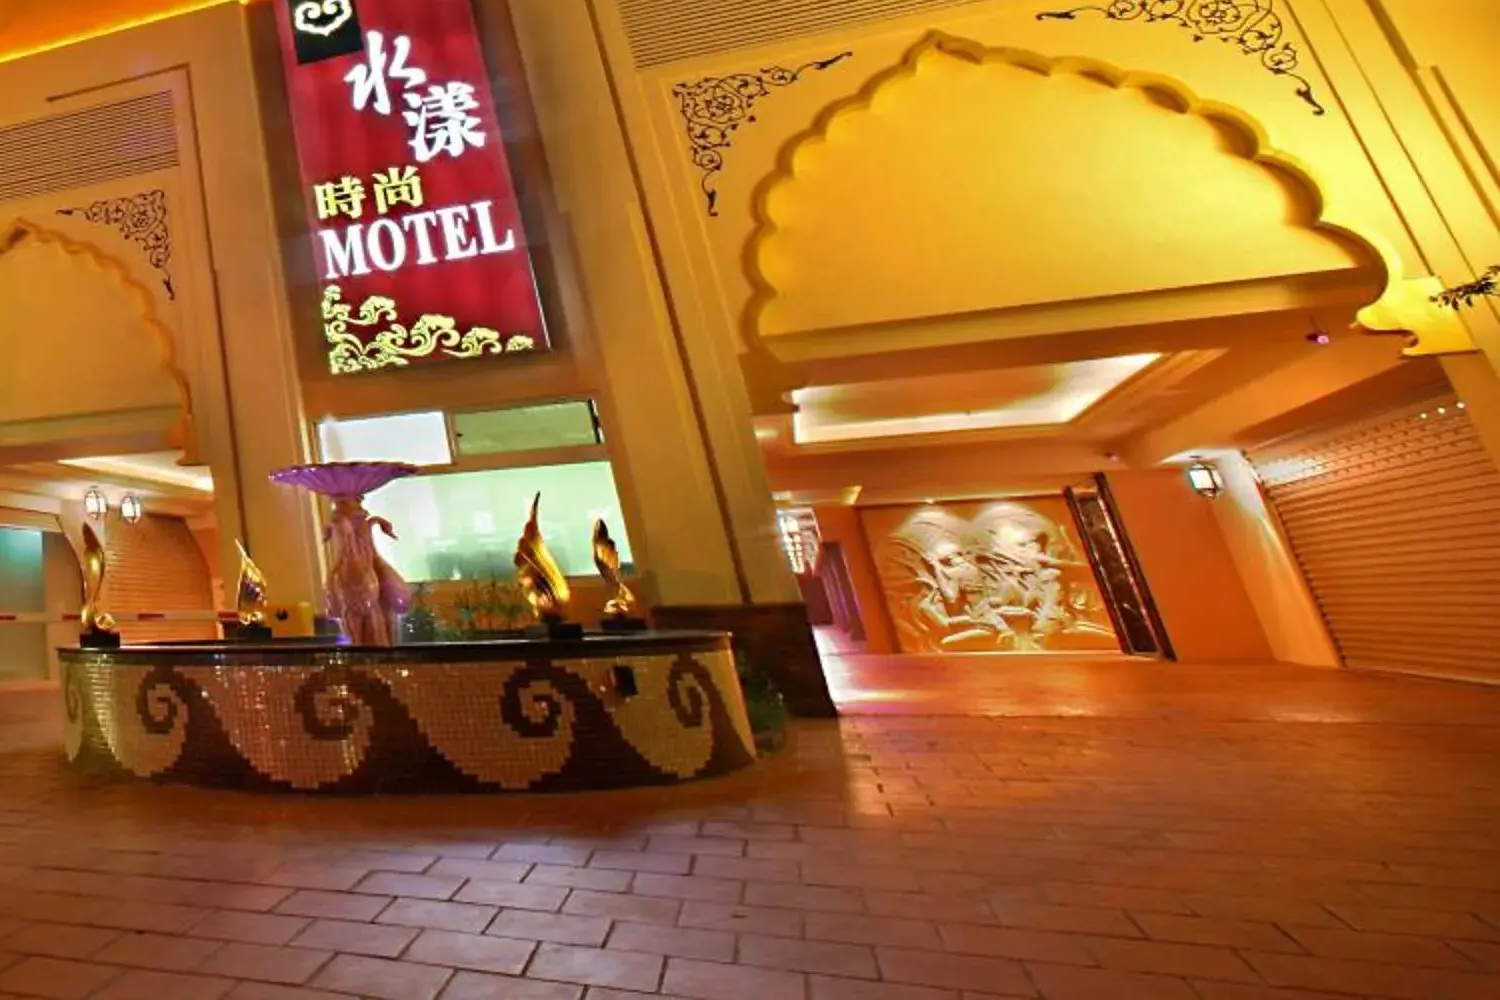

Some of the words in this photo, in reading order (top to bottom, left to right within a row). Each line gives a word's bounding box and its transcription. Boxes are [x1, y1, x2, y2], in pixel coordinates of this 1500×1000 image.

[344, 31, 486, 162] 水漾
[314, 166, 424, 220] 時尚
[319, 201, 514, 279] MOTEL
